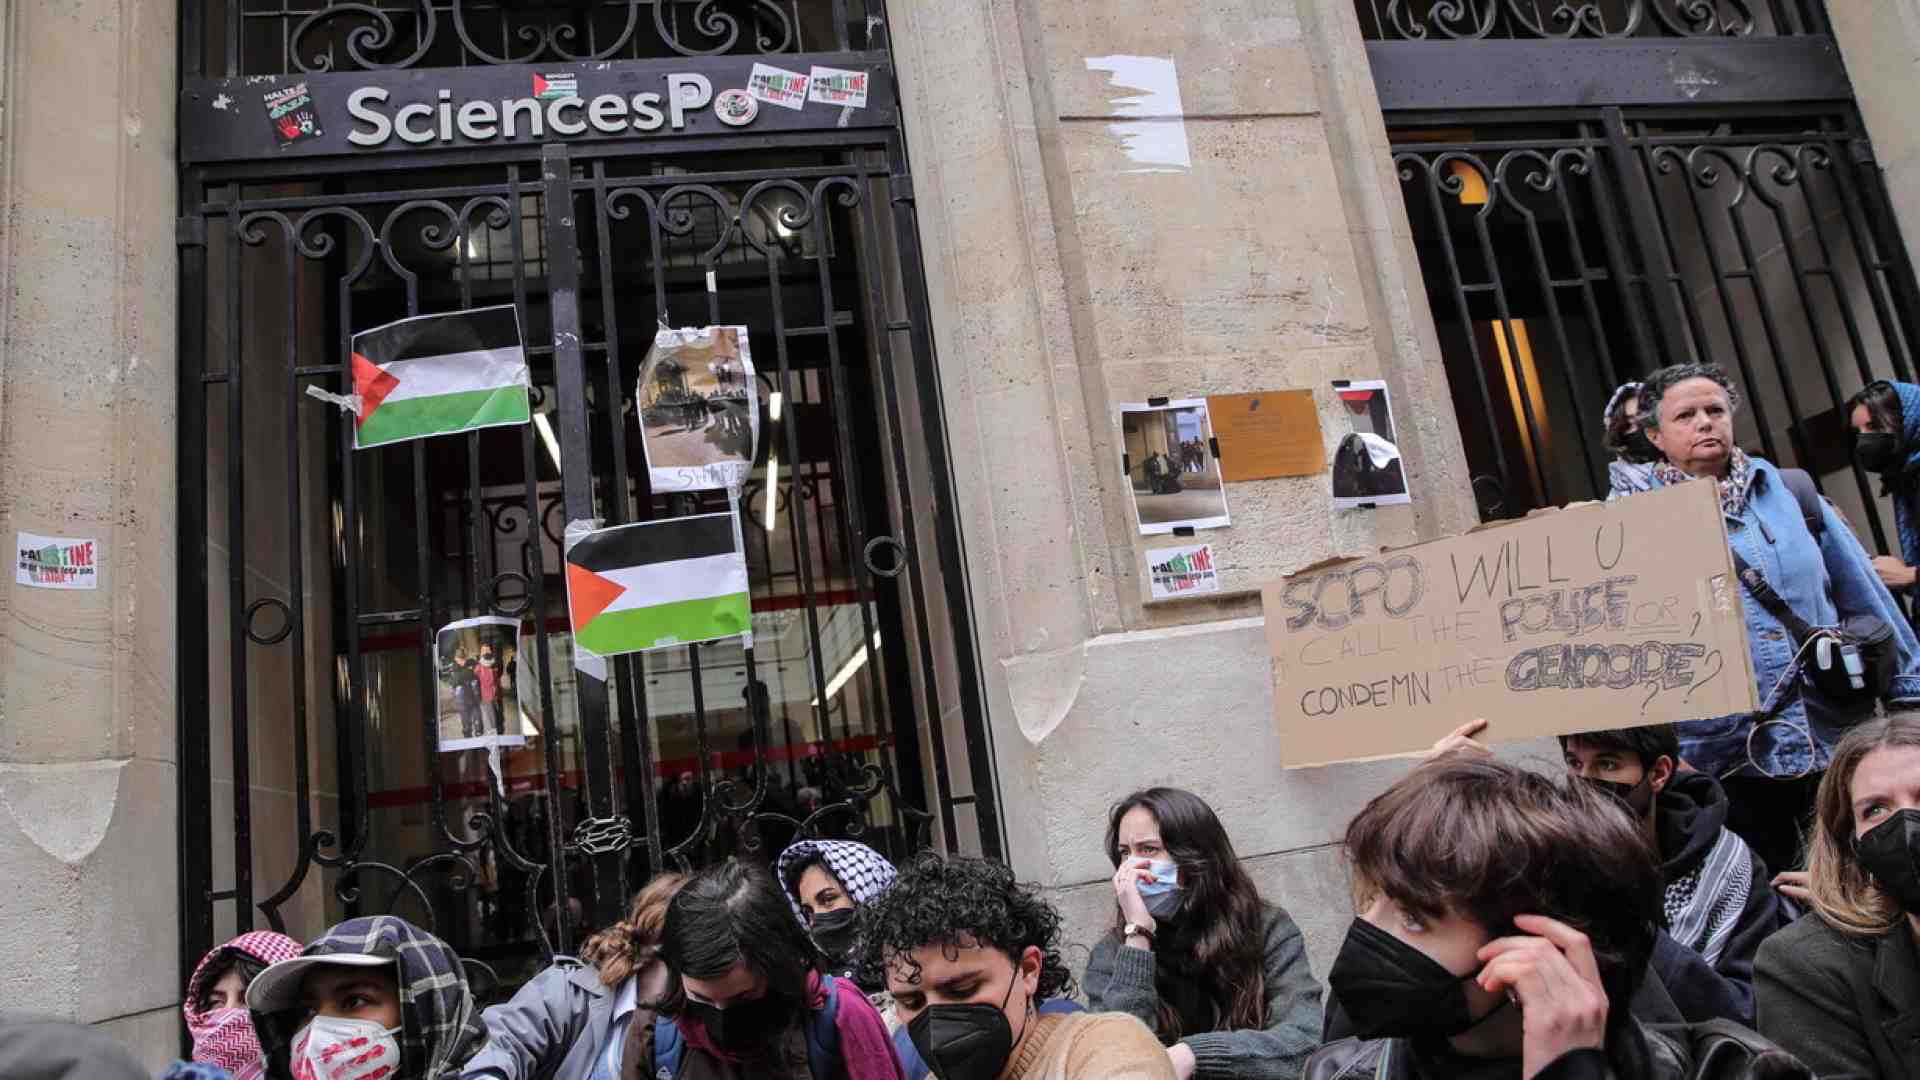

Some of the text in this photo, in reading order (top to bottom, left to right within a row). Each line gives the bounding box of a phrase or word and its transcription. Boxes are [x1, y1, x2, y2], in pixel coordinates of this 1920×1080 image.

[1280, 519, 1625, 632] SCPO WILL U
[1300, 624, 1400, 666] CALL
[1407, 611, 1481, 644] THE
[1500, 575, 1638, 643] POLICE
[1300, 671, 1433, 717] CONDEMN
[1440, 658, 1498, 693] THE
